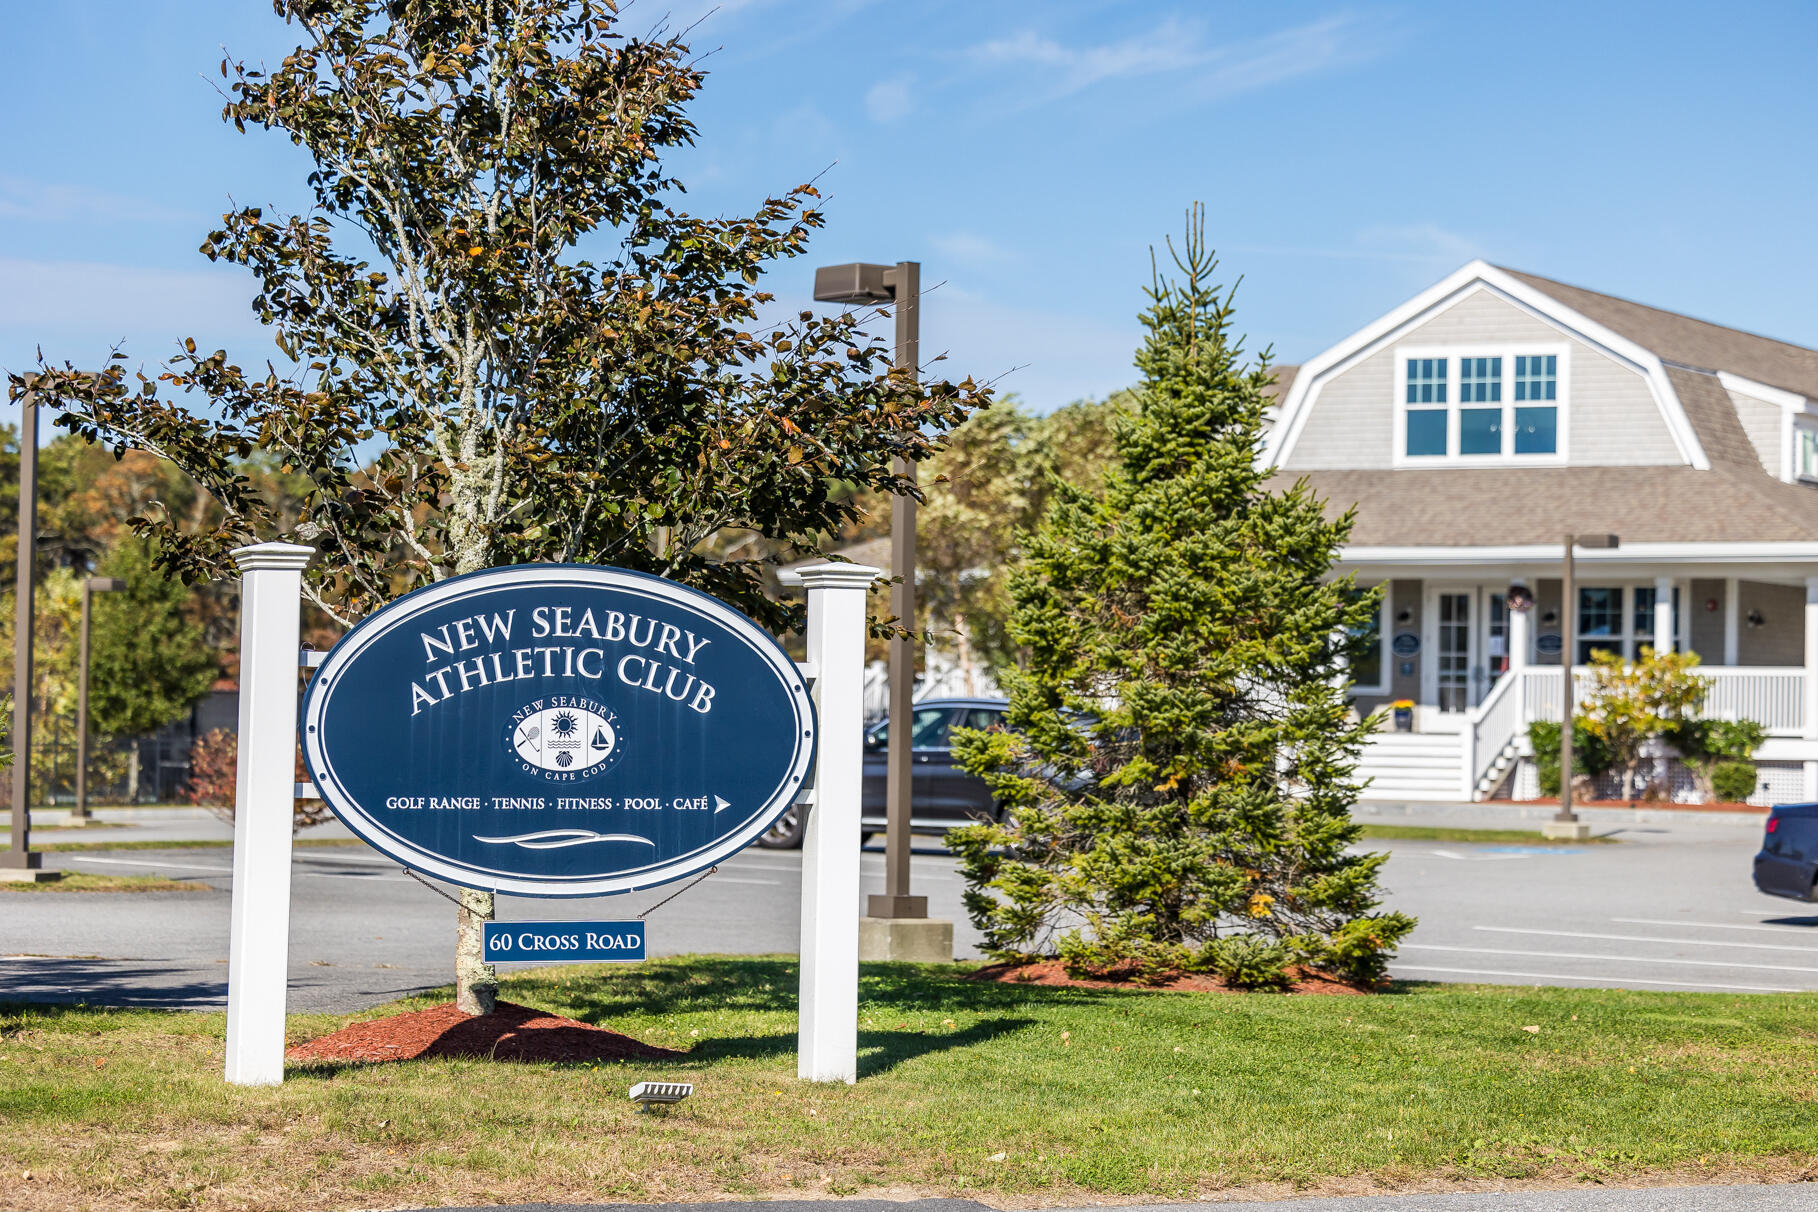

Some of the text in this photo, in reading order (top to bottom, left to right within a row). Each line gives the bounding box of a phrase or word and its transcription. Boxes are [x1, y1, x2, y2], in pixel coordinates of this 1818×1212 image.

[420, 606, 712, 665] NEW SEABURY
[411, 646, 716, 717] ATHLETIC CLUB
[512, 696, 617, 723] NEW SEABURY
[522, 763, 606, 781] ON CAPE COD
[386, 795, 708, 810] GOLF RANGE TENNIS FITNESS POOL CAFÉ
[489, 932, 641, 951] 60 CROSS ROAD
